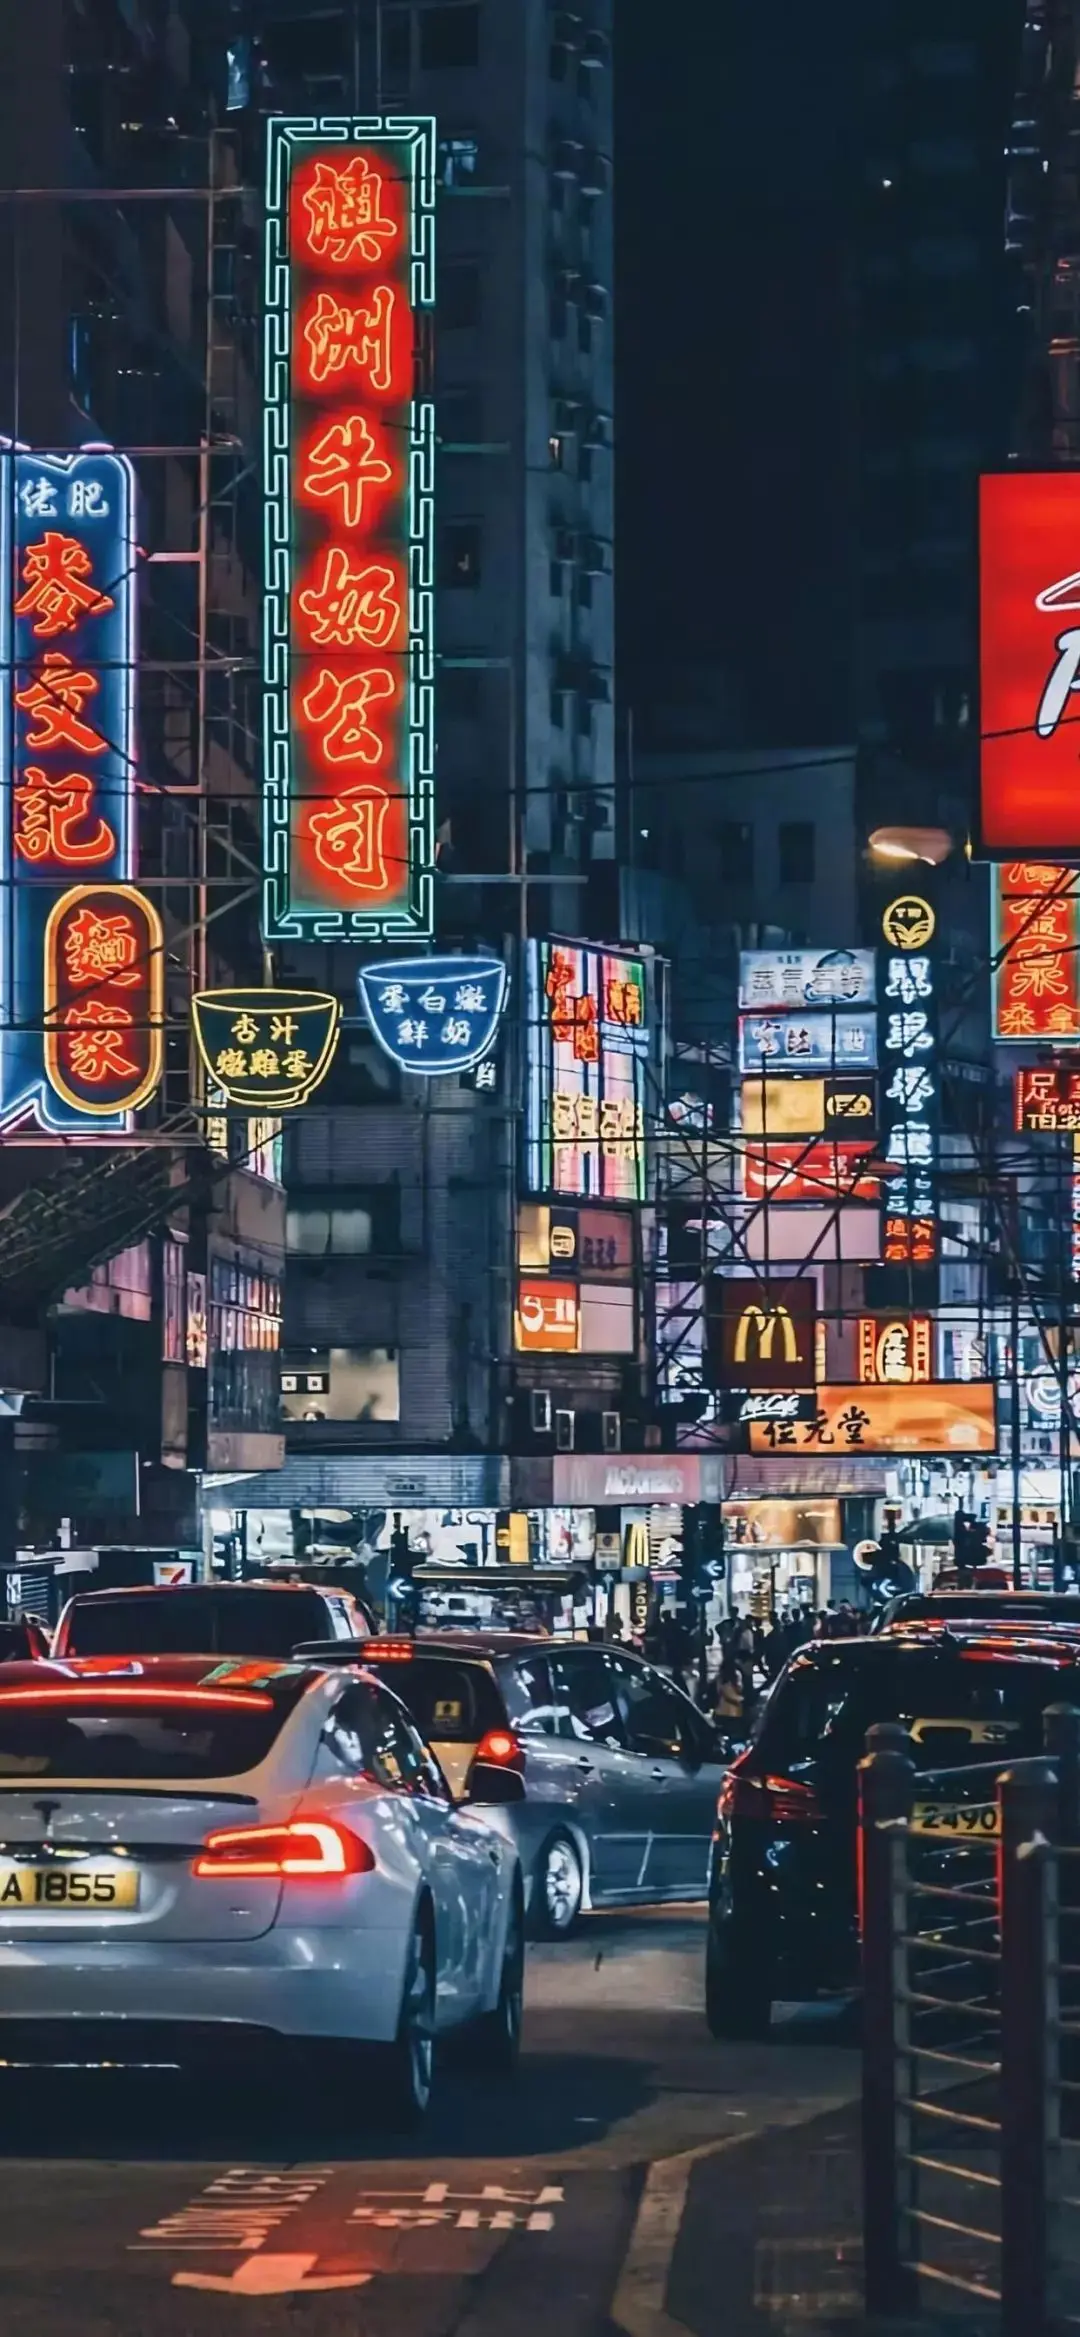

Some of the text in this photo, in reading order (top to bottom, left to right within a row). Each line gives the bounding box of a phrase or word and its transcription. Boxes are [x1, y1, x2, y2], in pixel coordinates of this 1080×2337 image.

[299, 156, 401, 890] 澳洲牛奶公司
[14, 532, 115, 861] 麥文記
[65, 909, 141, 1081] 麵家
[231, 1014, 299, 1045] 杏汁
[397, 1018, 471, 1048] 鮮奶
[1000, 1003, 1080, 1034] 桑拿
[763, 1405, 871, 1446] 位元堂
[921, 1806, 997, 1830] 2490
[35, 1873, 116, 1902] 1855
